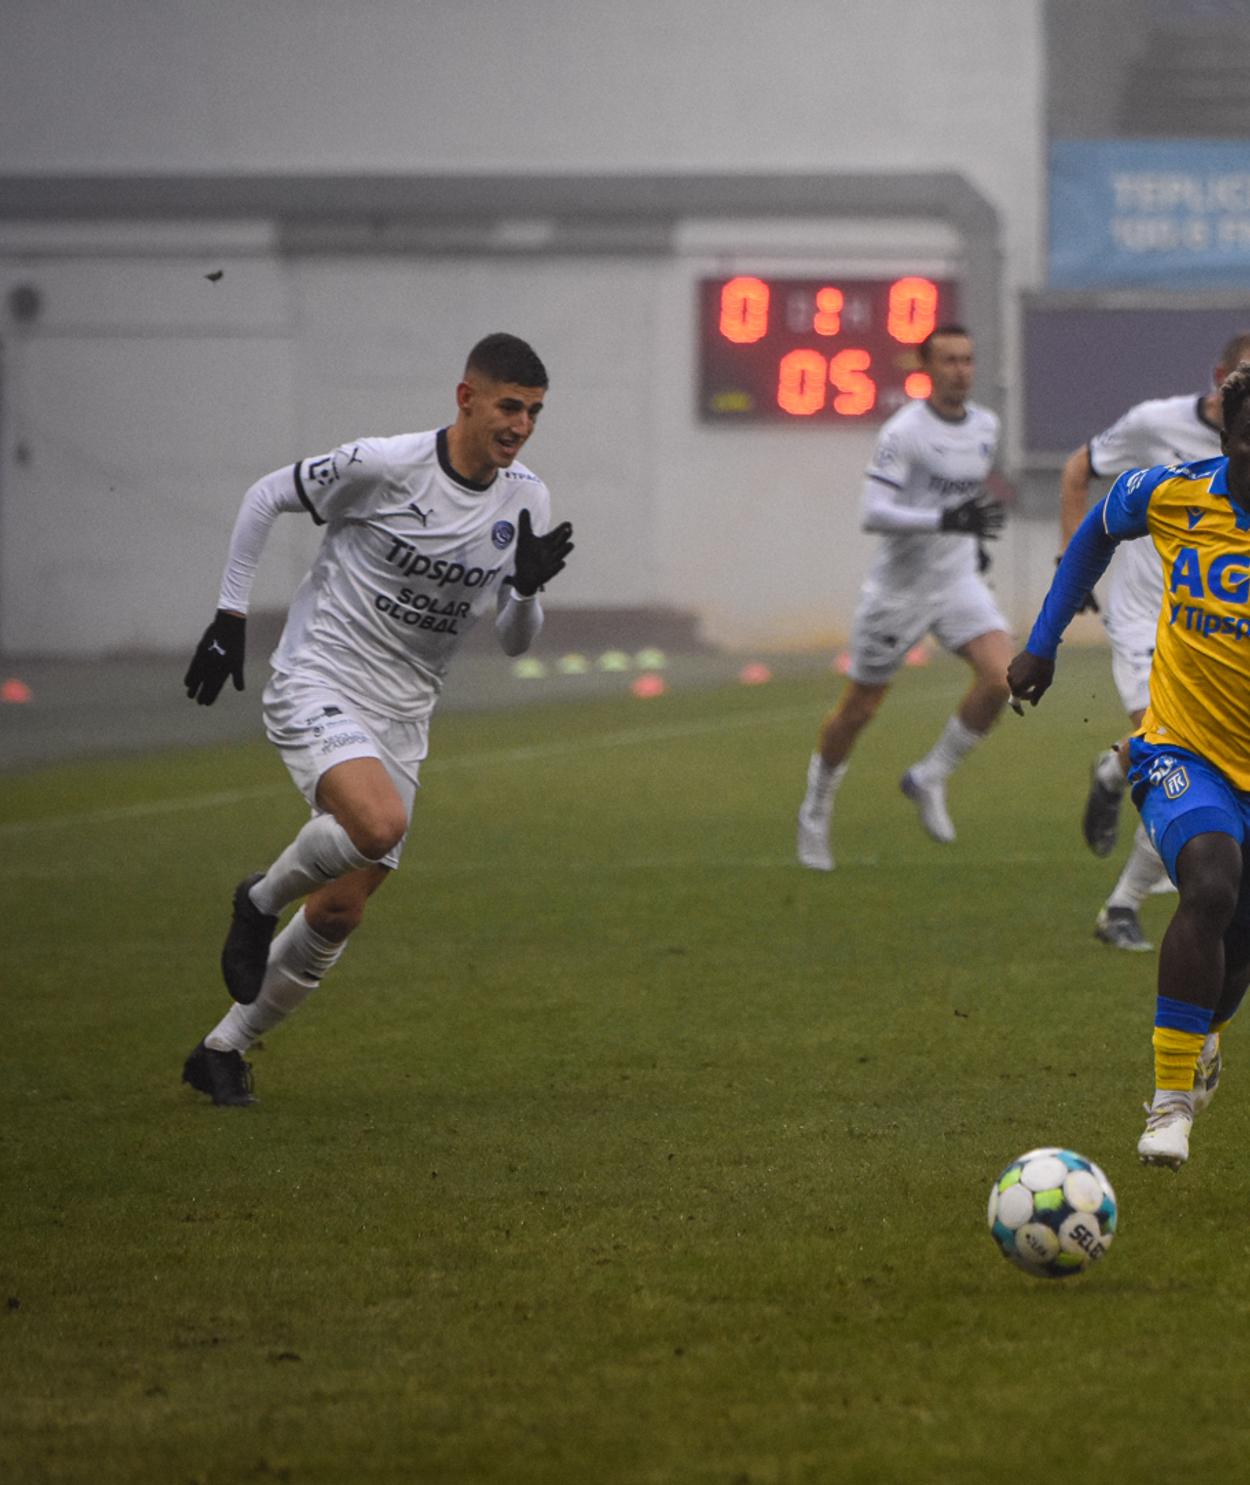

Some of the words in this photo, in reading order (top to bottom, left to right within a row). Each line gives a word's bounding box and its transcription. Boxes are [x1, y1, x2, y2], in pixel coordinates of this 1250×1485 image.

[719, 276, 770, 343] 0
[887, 276, 938, 343] 0
[386, 537, 502, 588] Tipspor
[375, 594, 458, 636] GLOBAL
[397, 588, 470, 618] SOLAR
